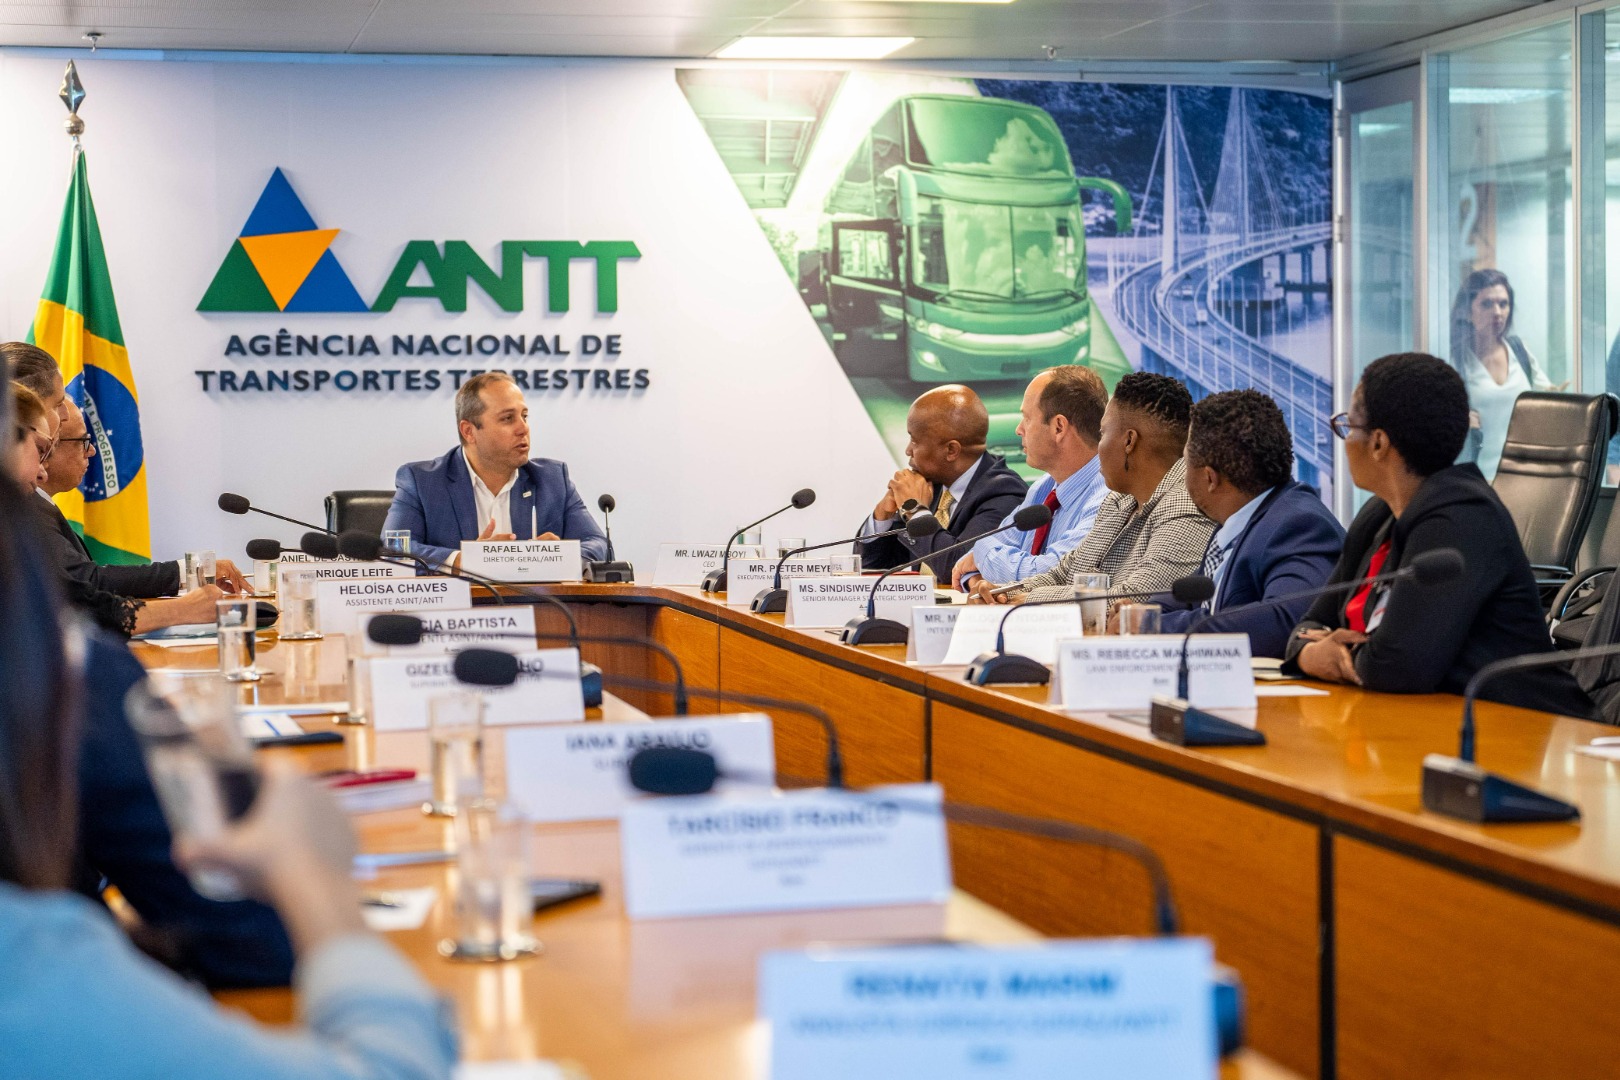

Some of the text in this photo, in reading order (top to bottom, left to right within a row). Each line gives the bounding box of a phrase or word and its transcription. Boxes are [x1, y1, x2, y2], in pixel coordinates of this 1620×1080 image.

[370, 240, 642, 312] ANTT
[224, 328, 622, 357] AGÊNCIA NACIONAL DE
[195, 368, 650, 393] TRANSPORTES TRESTRES
[92, 420, 116, 489] PROGRESSO
[483, 545, 560, 553] RAFAEL VITALE
[675, 549, 690, 557] MR.
[692, 550, 718, 558] LWAZI
[280, 554, 311, 562] ANIEL
[483, 555, 563, 563] DIRETOR-GERAL/ANTT
[702, 560, 716, 568] CEO
[316, 569, 358, 578] NRIQUE
[362, 568, 393, 577] LEITE
[397, 582, 448, 593] CHAVES
[799, 584, 817, 593] MS.
[820, 584, 872, 593] SINDISIWE
[345, 598, 393, 606] ASSISTENTE
[447, 617, 517, 630] BAPTISTA
